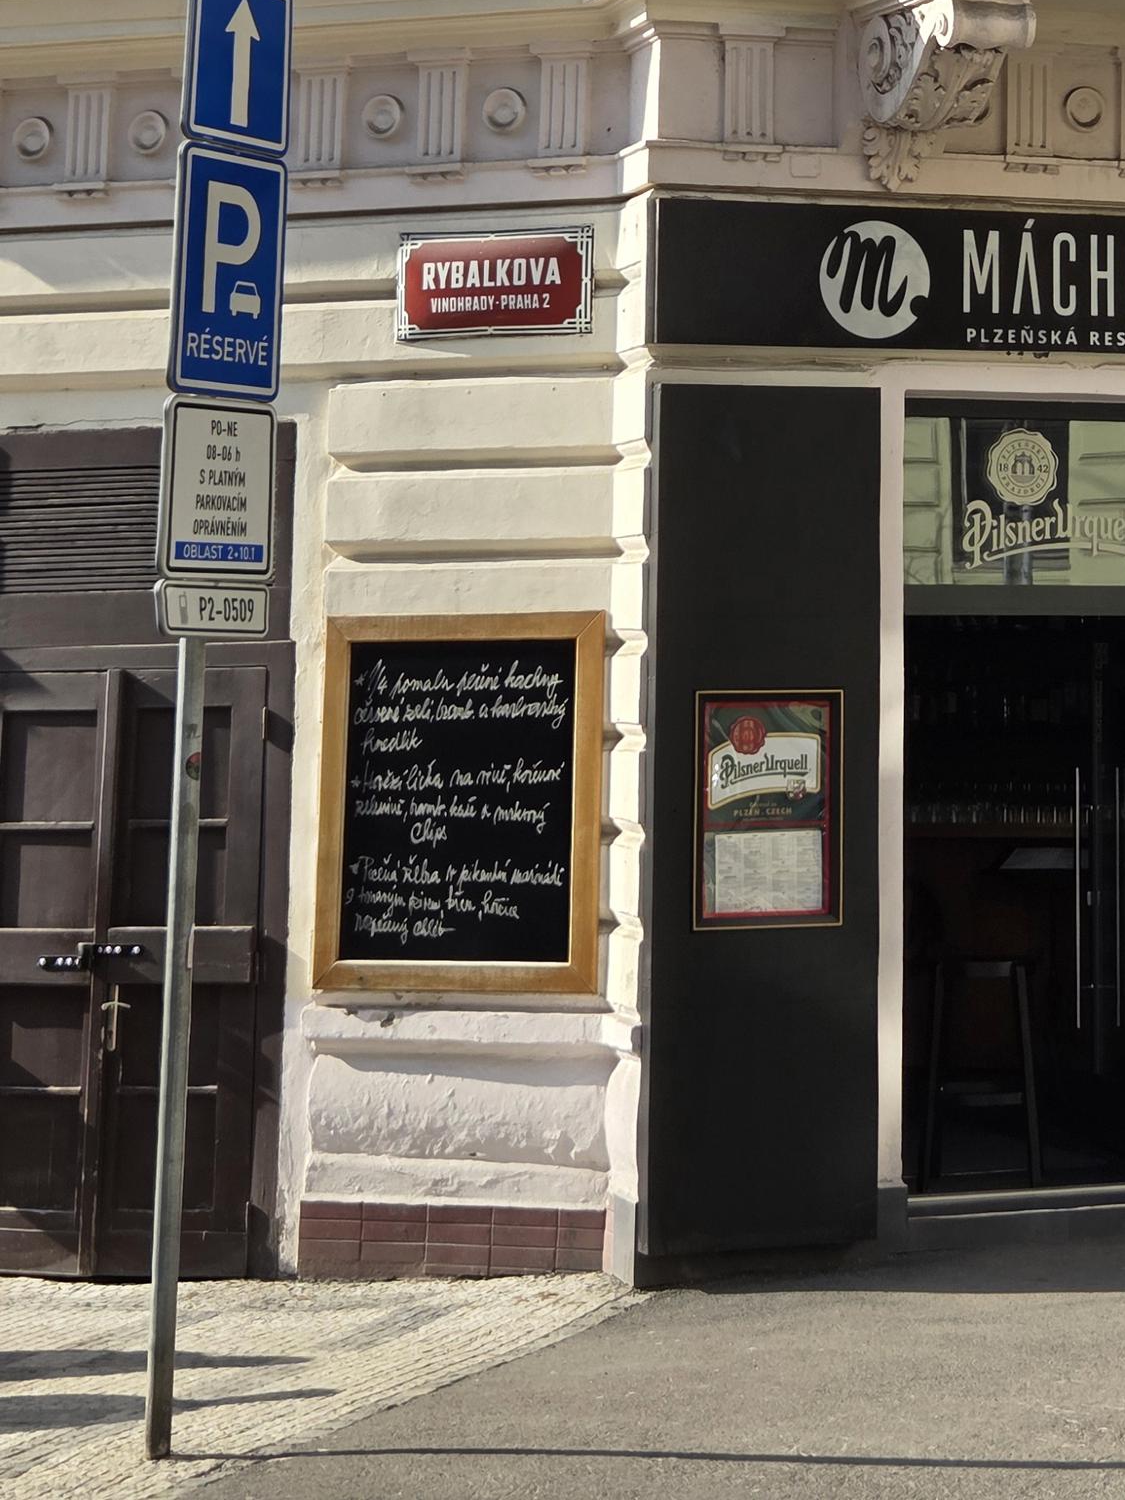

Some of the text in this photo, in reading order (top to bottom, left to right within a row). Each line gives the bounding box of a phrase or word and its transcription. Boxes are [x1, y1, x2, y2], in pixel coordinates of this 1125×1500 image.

[202, 180, 261, 313] P
[422, 257, 561, 290] RYBALKOVA
[542, 293, 550, 308] 2
[966, 326, 1078, 346] PLZEŇSKÁ
[186, 328, 269, 367] RÉSERVÉ
[211, 419, 238, 438] PO-NE
[206, 444, 232, 462] 08-06
[199, 466, 246, 488] S PLATNÝM
[999, 463, 1049, 474] 18 42
[195, 492, 247, 513] PARKOVACÍM
[193, 516, 247, 538] OPRÁVNĚNÍM
[962, 499, 1056, 570] Pilsner
[183, 543, 223, 560] OBLAST
[199, 596, 254, 623] P2-0509
[720, 752, 808, 789] Pilsner Urquell
